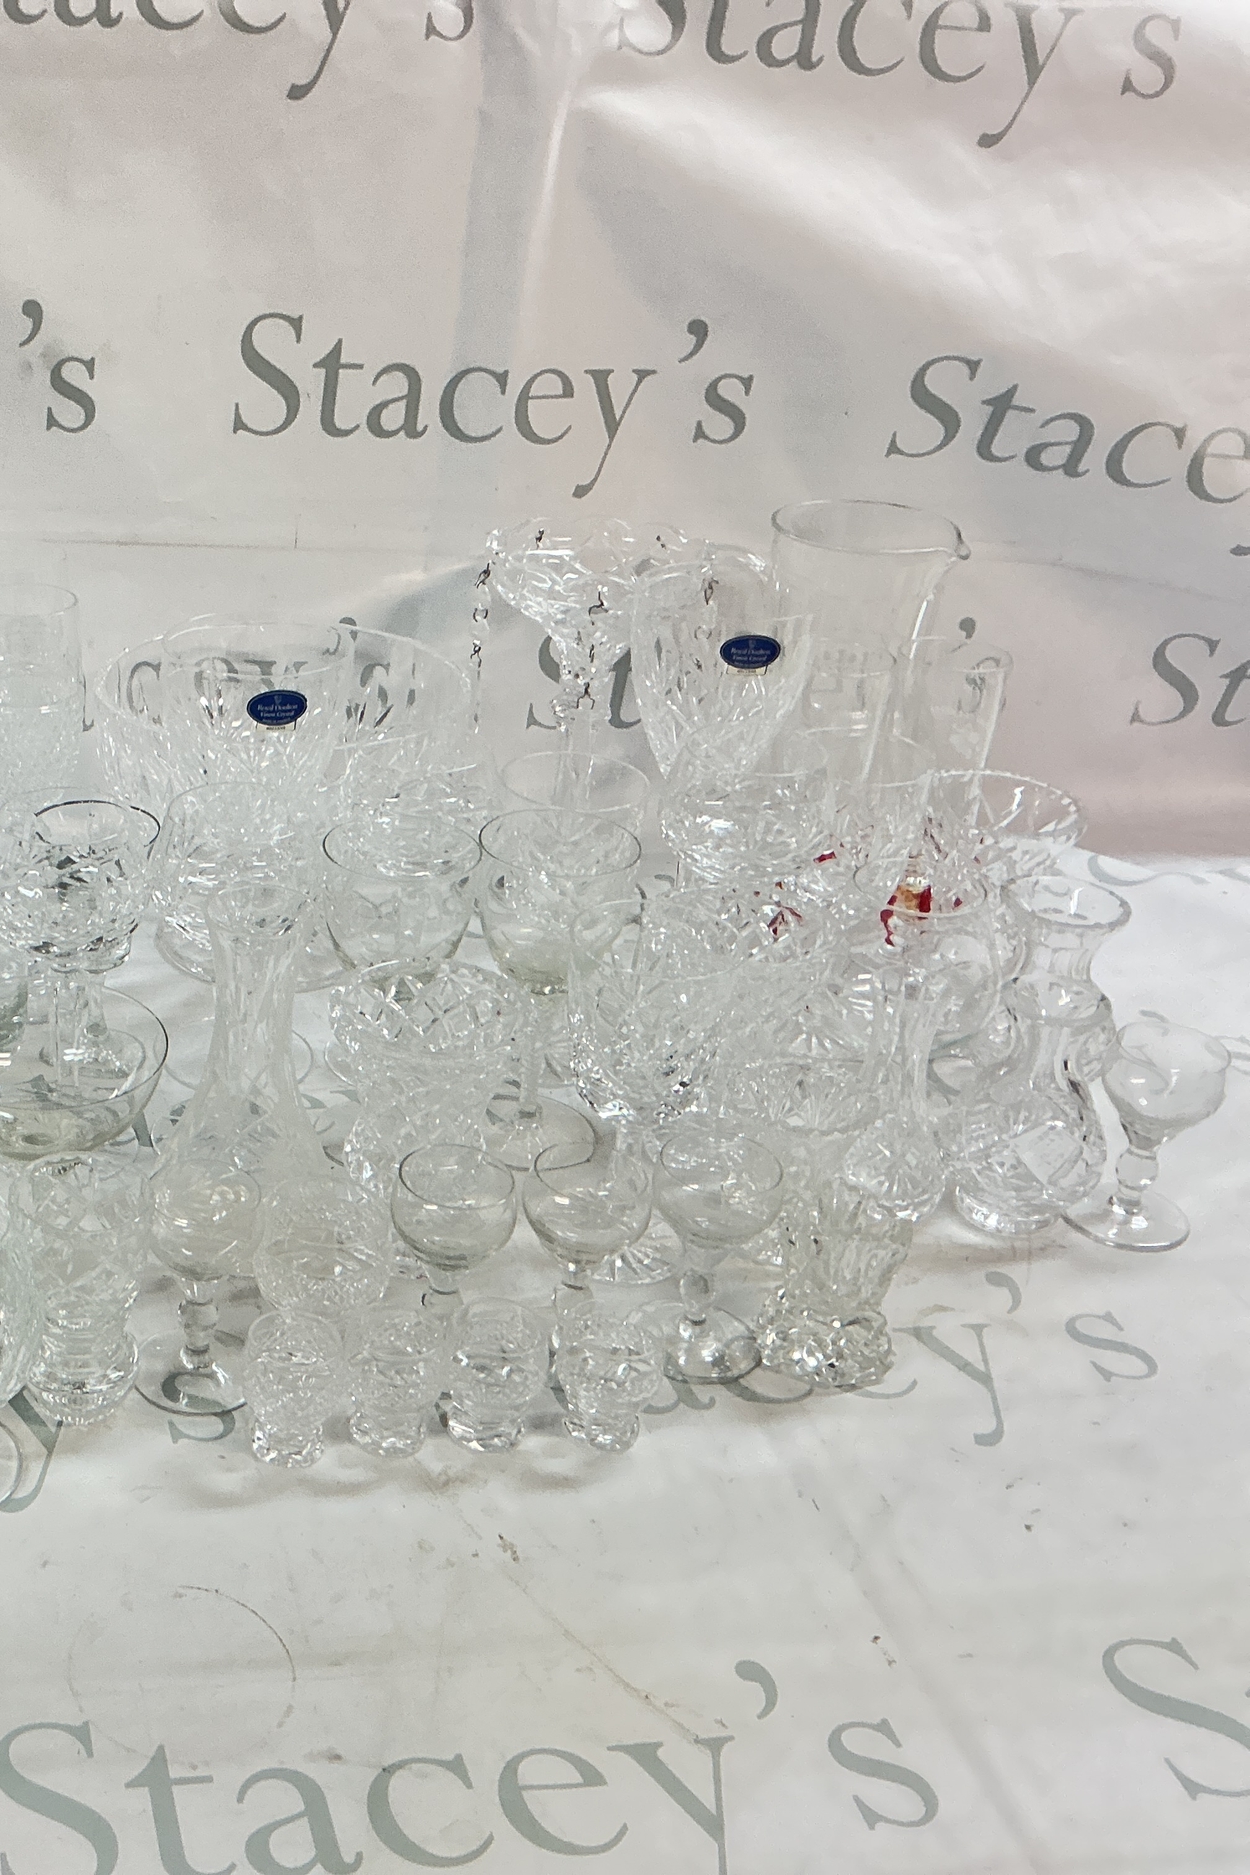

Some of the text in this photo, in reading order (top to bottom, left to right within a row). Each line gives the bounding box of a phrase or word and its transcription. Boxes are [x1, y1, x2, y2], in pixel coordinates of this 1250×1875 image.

[617, 0, 1183, 148] taceys
[233, 312, 755, 500] Stacey's
[884, 355, 1250, 557] Stace
